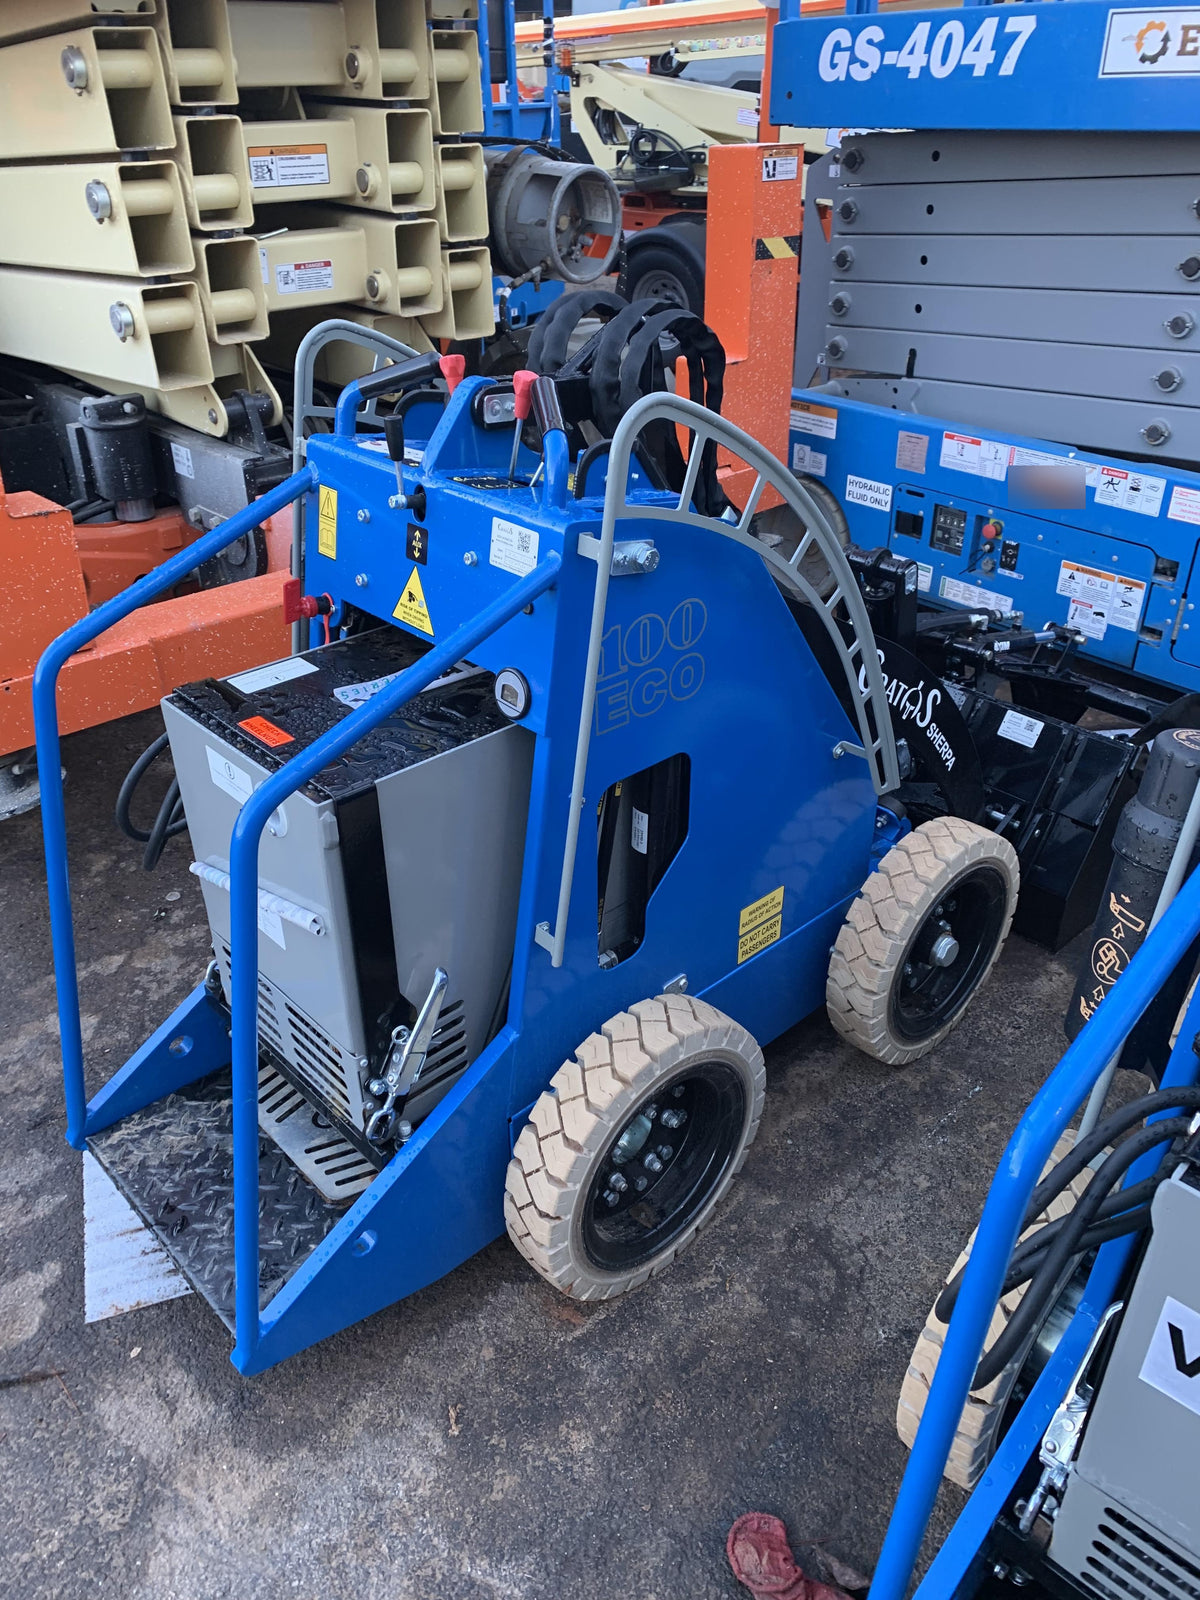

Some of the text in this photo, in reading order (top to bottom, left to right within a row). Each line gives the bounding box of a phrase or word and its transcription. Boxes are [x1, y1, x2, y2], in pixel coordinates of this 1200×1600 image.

[818, 14, 1037, 82] GS-4047
[848, 490, 889, 507] FLUID ONLY
[849, 479, 890, 496] HYDRAULIC
[412, 540, 422, 549] AUX
[598, 598, 708, 683] 100
[595, 652, 706, 736] ECO
[260, 722, 280, 736] CHECK
[927, 723, 956, 771] SHERPA
[741, 901, 782, 929] RADIUS OF ACTION
[748, 896, 776, 917] WARNING OF
[740, 919, 780, 949] DO NOT CARRY
[741, 930, 777, 959] PASSENGERS
